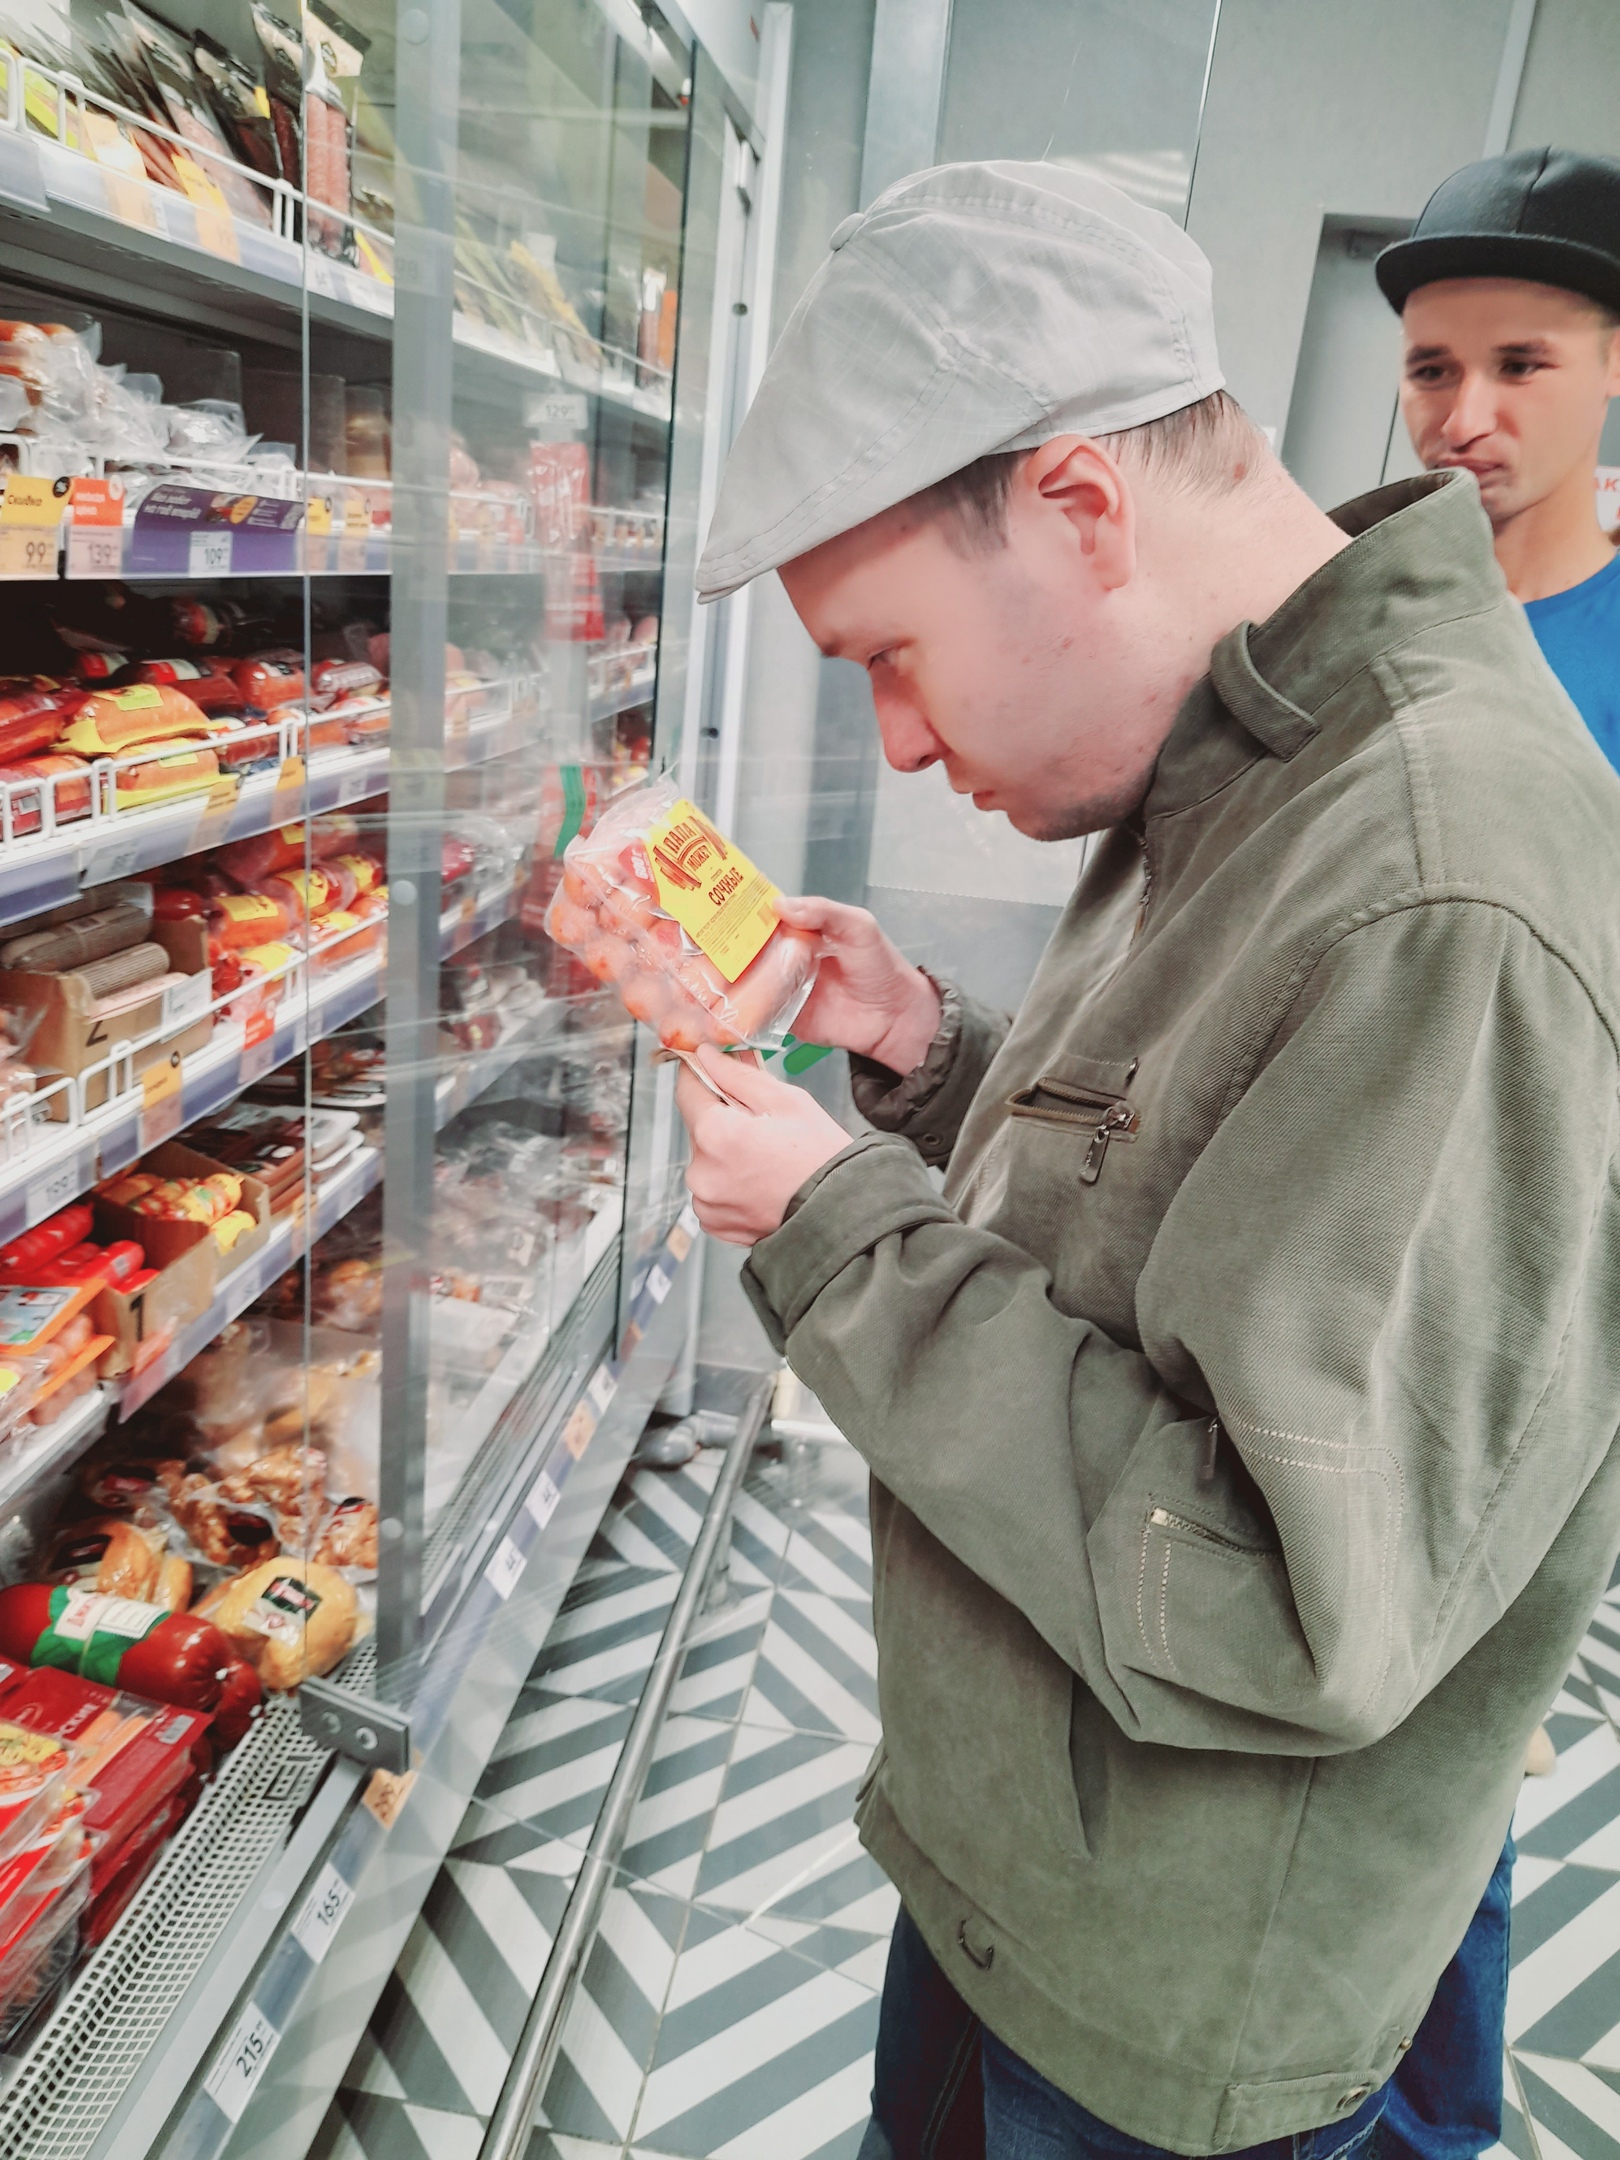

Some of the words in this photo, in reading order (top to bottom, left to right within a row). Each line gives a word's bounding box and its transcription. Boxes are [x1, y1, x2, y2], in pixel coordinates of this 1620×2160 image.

[26, 541, 46, 563] 99
[664, 823, 696, 853] ПАПА
[687, 845, 713, 871] МОЖЕТ
[708, 867, 744, 907] СОЧНЫЕ
[317, 1889, 340, 1926] 165
[236, 2031, 264, 2078] 215
